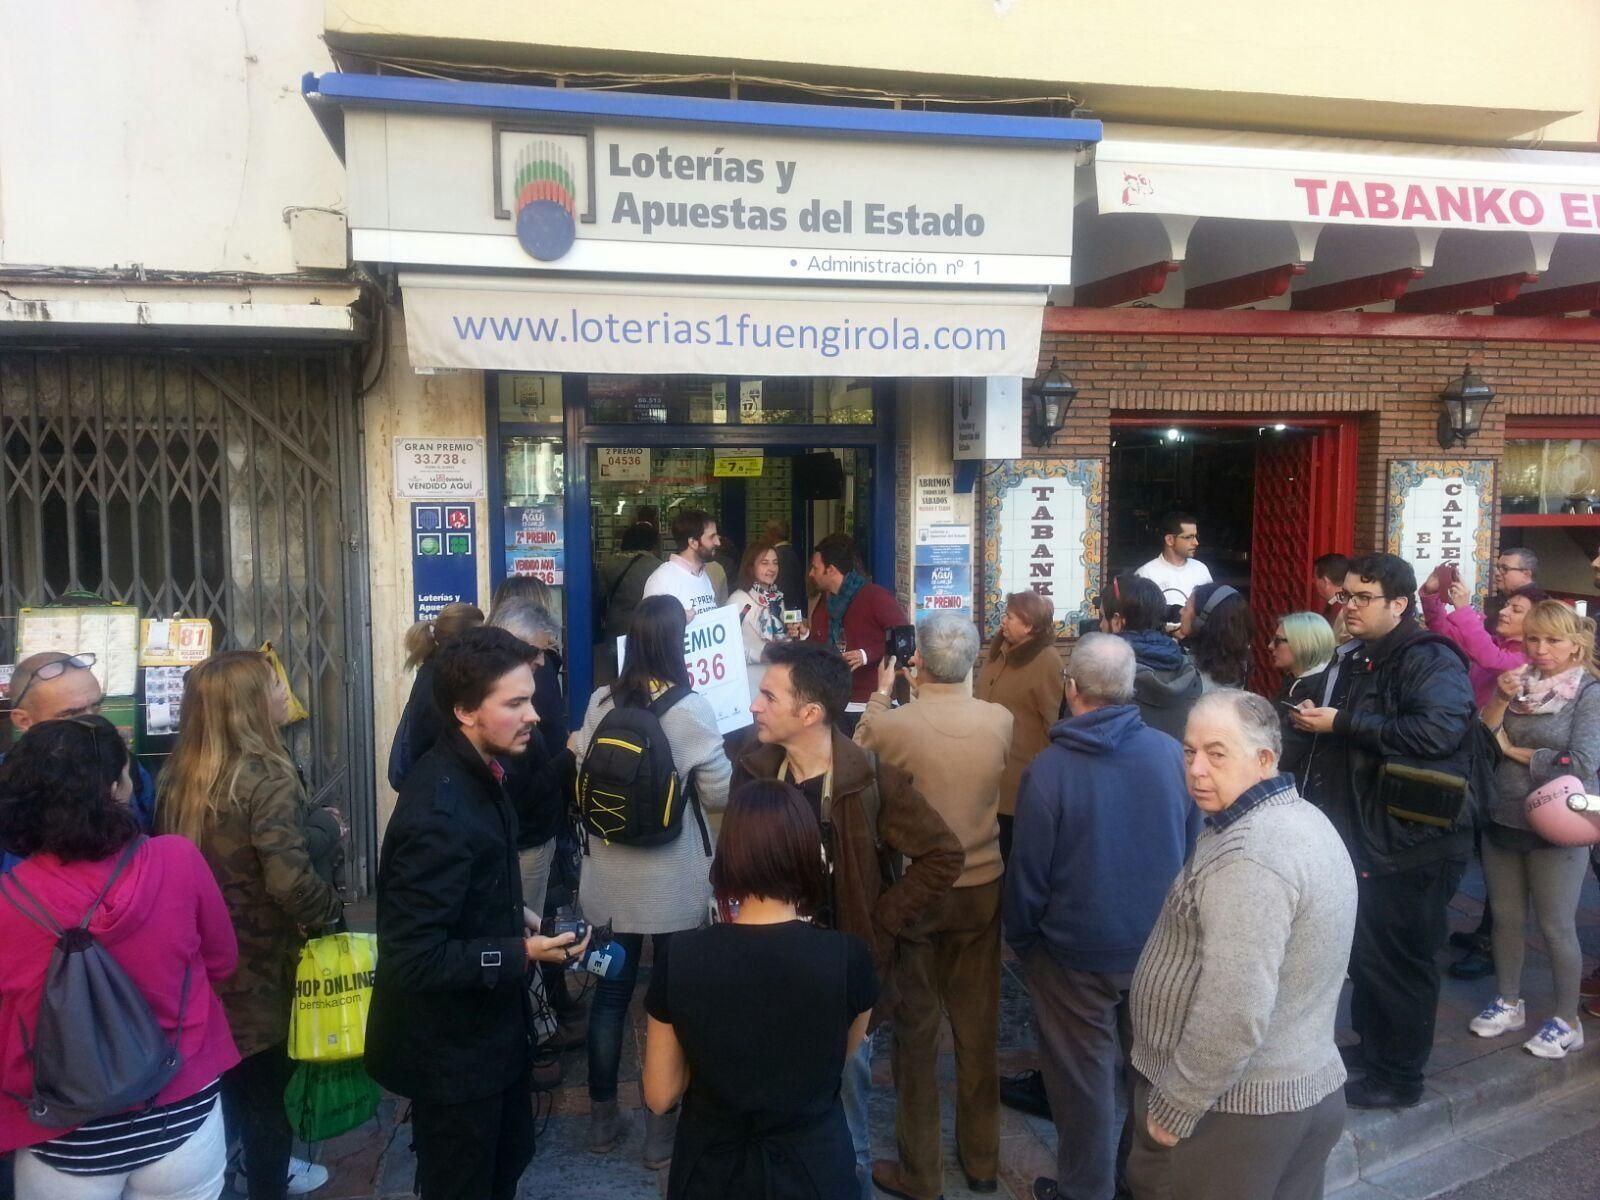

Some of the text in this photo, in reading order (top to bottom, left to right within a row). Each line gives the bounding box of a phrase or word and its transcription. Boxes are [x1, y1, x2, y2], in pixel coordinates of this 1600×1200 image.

[609, 144, 797, 194] Loterías y
[1294, 178, 1544, 226] TABANKO
[611, 191, 985, 237] Apuestas del Estado
[808, 255, 937, 274] Administración
[974, 260, 981, 275] 1
[453, 308, 1006, 357] www.loterias1fuengirola.com
[404, 443, 474, 451] GRAN PREMIO
[414, 453, 459, 464] 33.738
[608, 456, 641, 465] 04536
[450, 481, 473, 489] AQUÍ
[919, 478, 951, 487] ABRIMOS
[526, 531, 556, 544] PREMIO
[1416, 532, 1430, 559] EL
[454, 595, 461, 603] y
[934, 596, 962, 608] PREMIO
[419, 603, 447, 613] Apues
[181, 628, 205, 646] 81
[324, 970, 375, 996] ONLINE
[300, 995, 362, 1011] bershka.com
